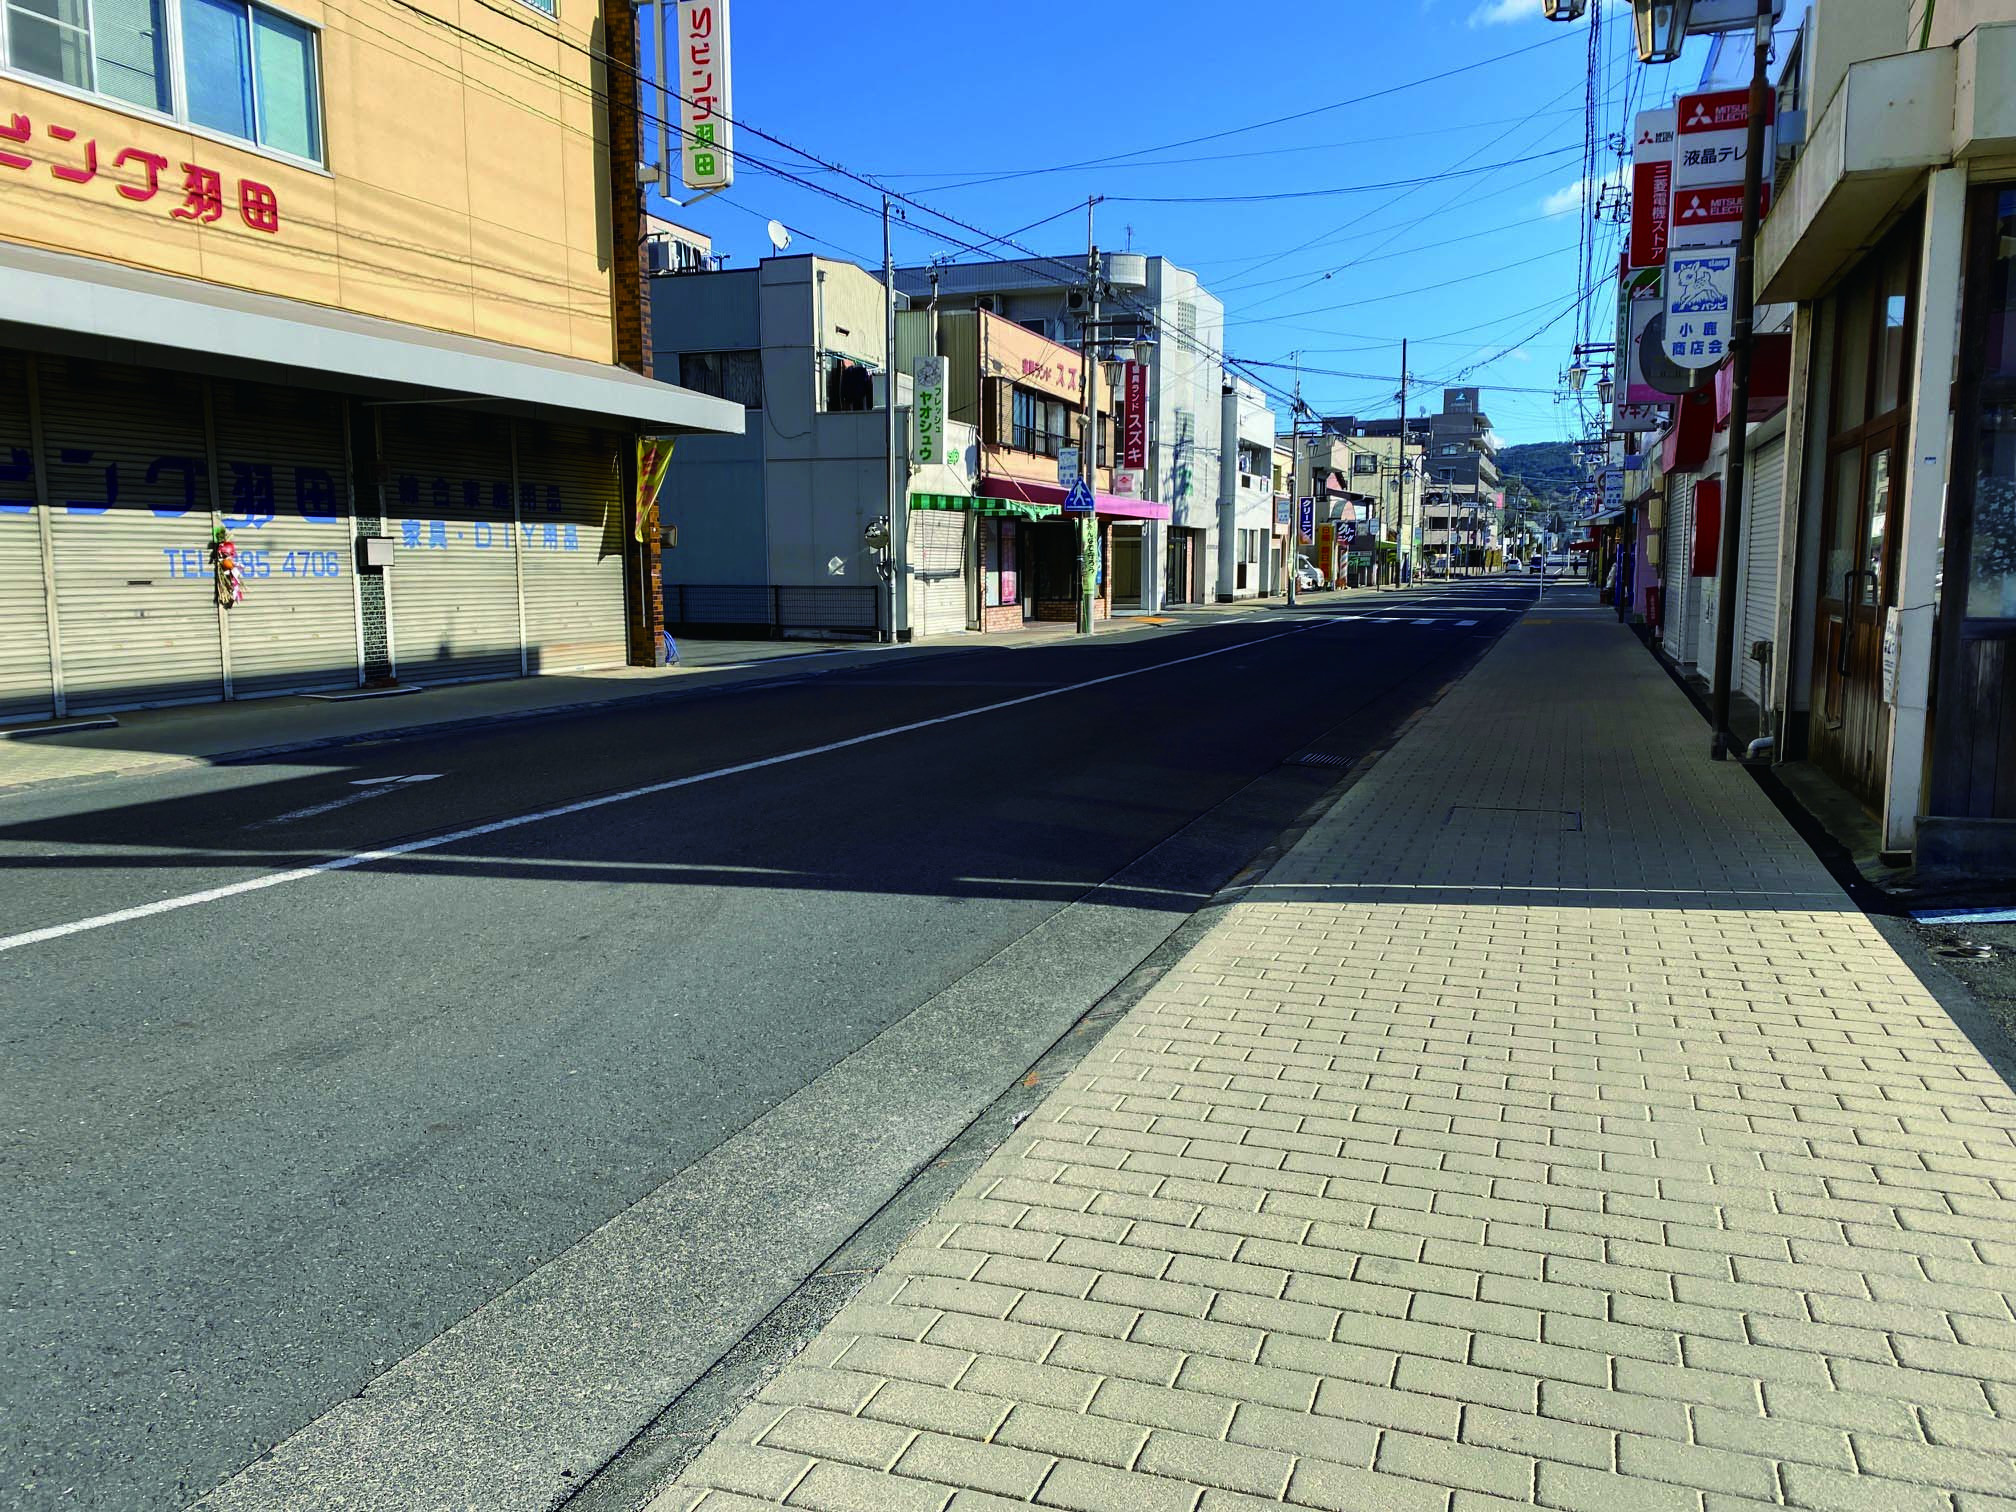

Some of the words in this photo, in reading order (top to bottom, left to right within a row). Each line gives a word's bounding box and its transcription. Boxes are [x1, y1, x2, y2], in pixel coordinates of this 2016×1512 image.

[1683, 146, 1748, 167] 液晶テレ
[1651, 165, 1669, 260] 三菱電機ストア
[1679, 321, 1718, 338] 小鹿
[1672, 340, 1723, 357] 商店会
[919, 391, 932, 461] ヤオシュウ
[163, 548, 215, 579] TEL
[282, 551, 340, 578] 4706
